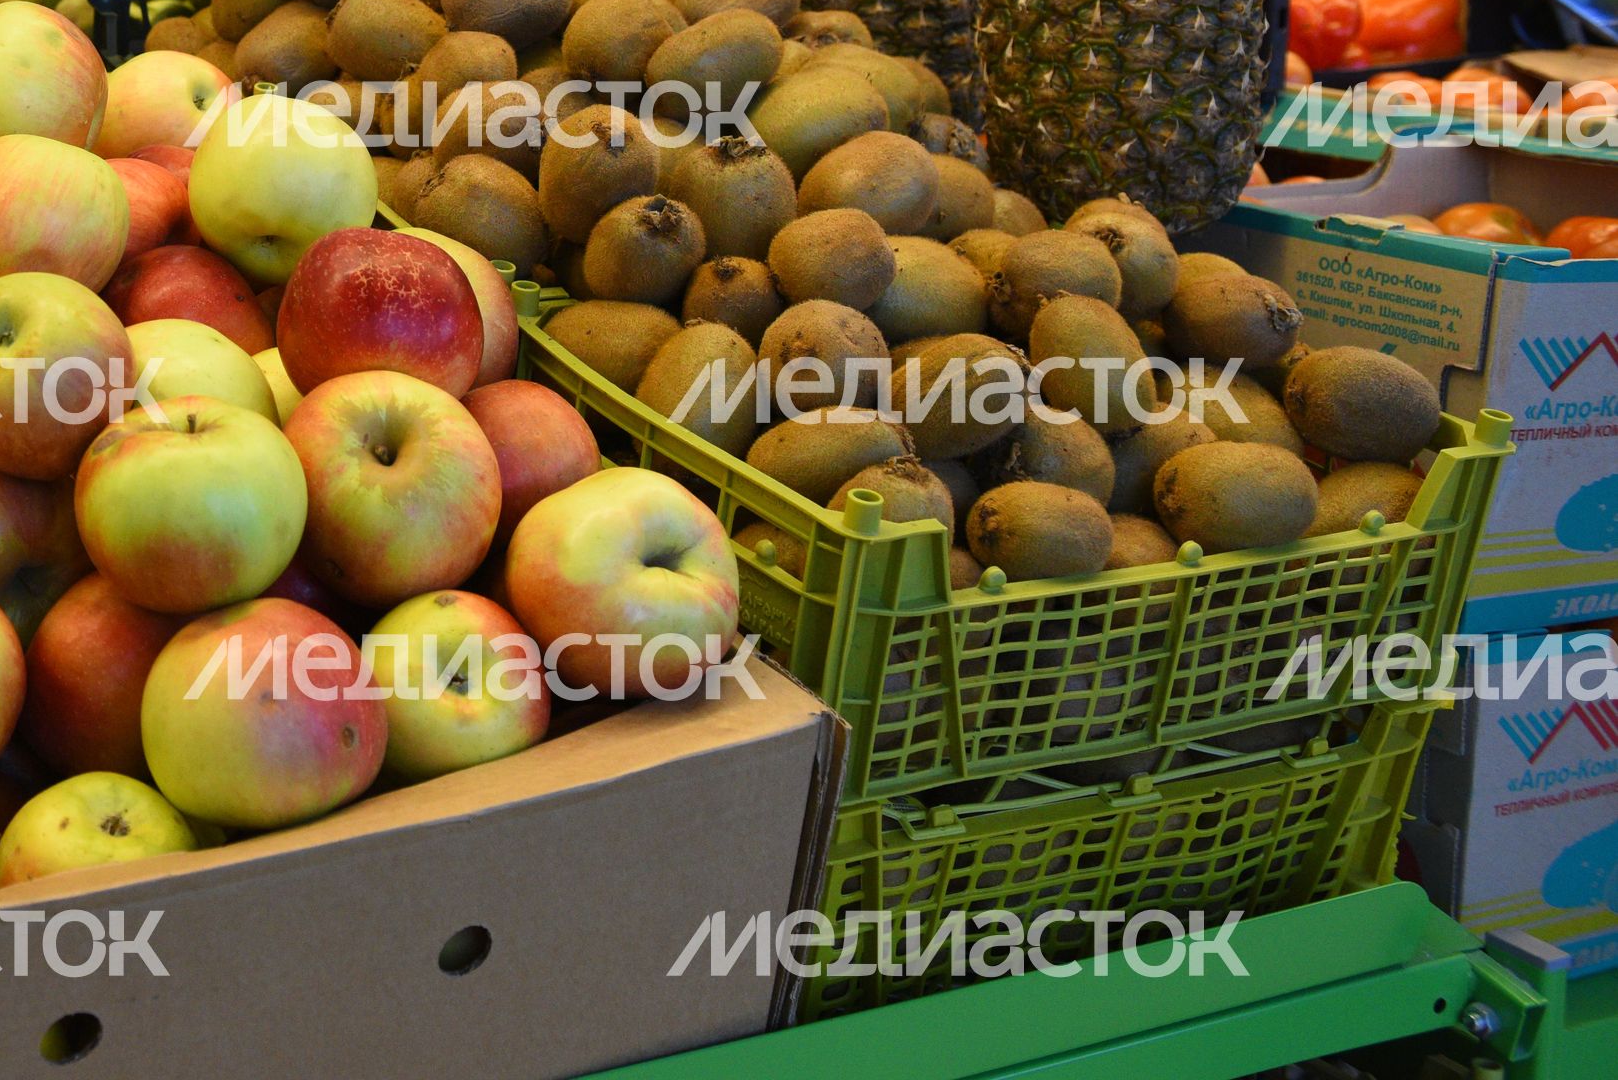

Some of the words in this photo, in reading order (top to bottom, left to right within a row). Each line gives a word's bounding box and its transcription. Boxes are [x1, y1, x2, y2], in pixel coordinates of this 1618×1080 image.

[1295, 270, 1336, 291] 361520,
[1339, 280, 1365, 297] КБР,
[1367, 286, 1438, 312] Баксанский
[1318, 256, 1353, 276] ООО
[1356, 266, 1443, 295] «Агро-Ком»
[1296, 305, 1329, 321] -mail:
[1332, 312, 1461, 352] agrocom2008@mail.ru
[1358, 303, 1375, 316] ул.
[1378, 306, 1444, 333] Школьная,
[1509, 423, 1592, 442] ТЕПЛИЧНЫЙ
